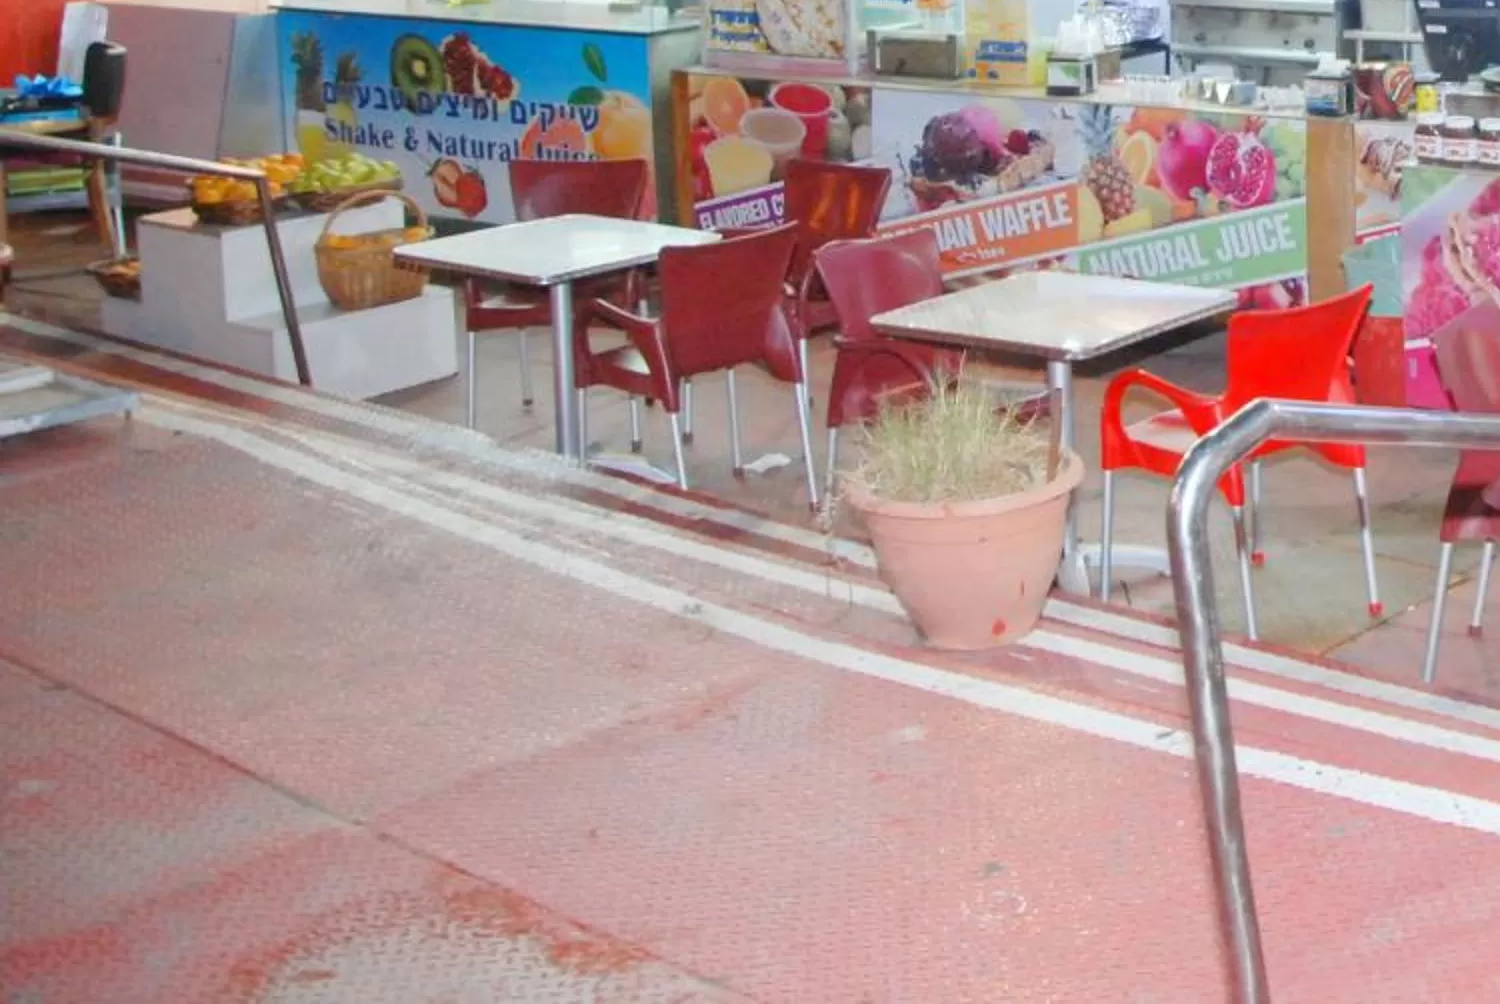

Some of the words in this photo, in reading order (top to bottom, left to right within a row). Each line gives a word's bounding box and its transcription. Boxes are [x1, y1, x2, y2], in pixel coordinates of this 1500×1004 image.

[323, 118, 395, 149] Shake
[403, 127, 419, 151] &
[427, 131, 520, 161] Natural
[700, 197, 771, 230] FLAVORED
[978, 192, 1073, 241] WAFFLE
[1089, 232, 1209, 277] NATURAL
[1216, 212, 1297, 261] JUICE
